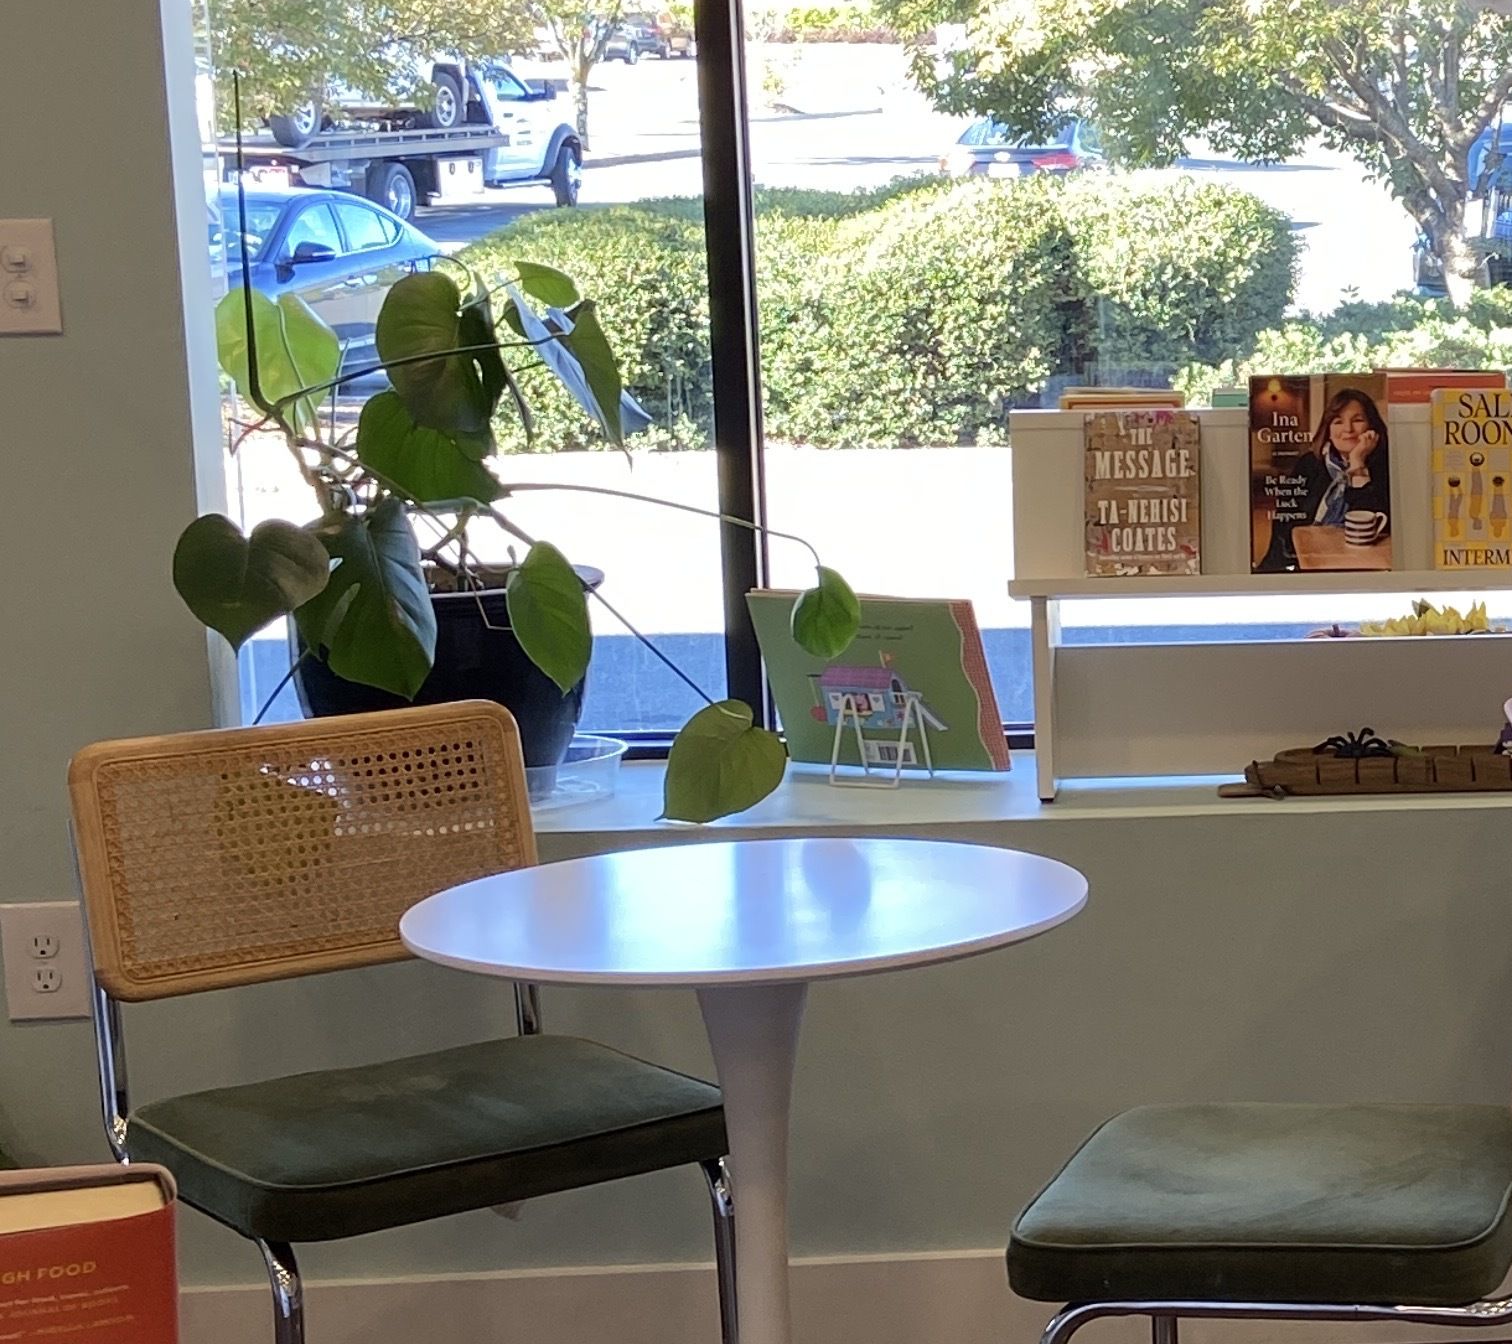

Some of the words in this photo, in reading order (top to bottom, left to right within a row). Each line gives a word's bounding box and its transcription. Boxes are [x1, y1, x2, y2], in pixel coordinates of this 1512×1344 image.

[1272, 412, 1299, 427] Ina
[1130, 428, 1153, 445] THE
[1257, 428, 1314, 444] Garten
[1094, 449, 1191, 480] MESSAGE
[1265, 474, 1277, 485] Be
[1279, 474, 1308, 488] Ready
[1264, 487, 1292, 497] When
[1293, 487, 1309, 497] the
[1097, 497, 1188, 525] TA-NEHISI
[1275, 498, 1298, 509] Luck
[1267, 510, 1308, 522] Happens
[1111, 526, 1178, 552] COATES
[37, 1261, 97, 1280] FOOD
